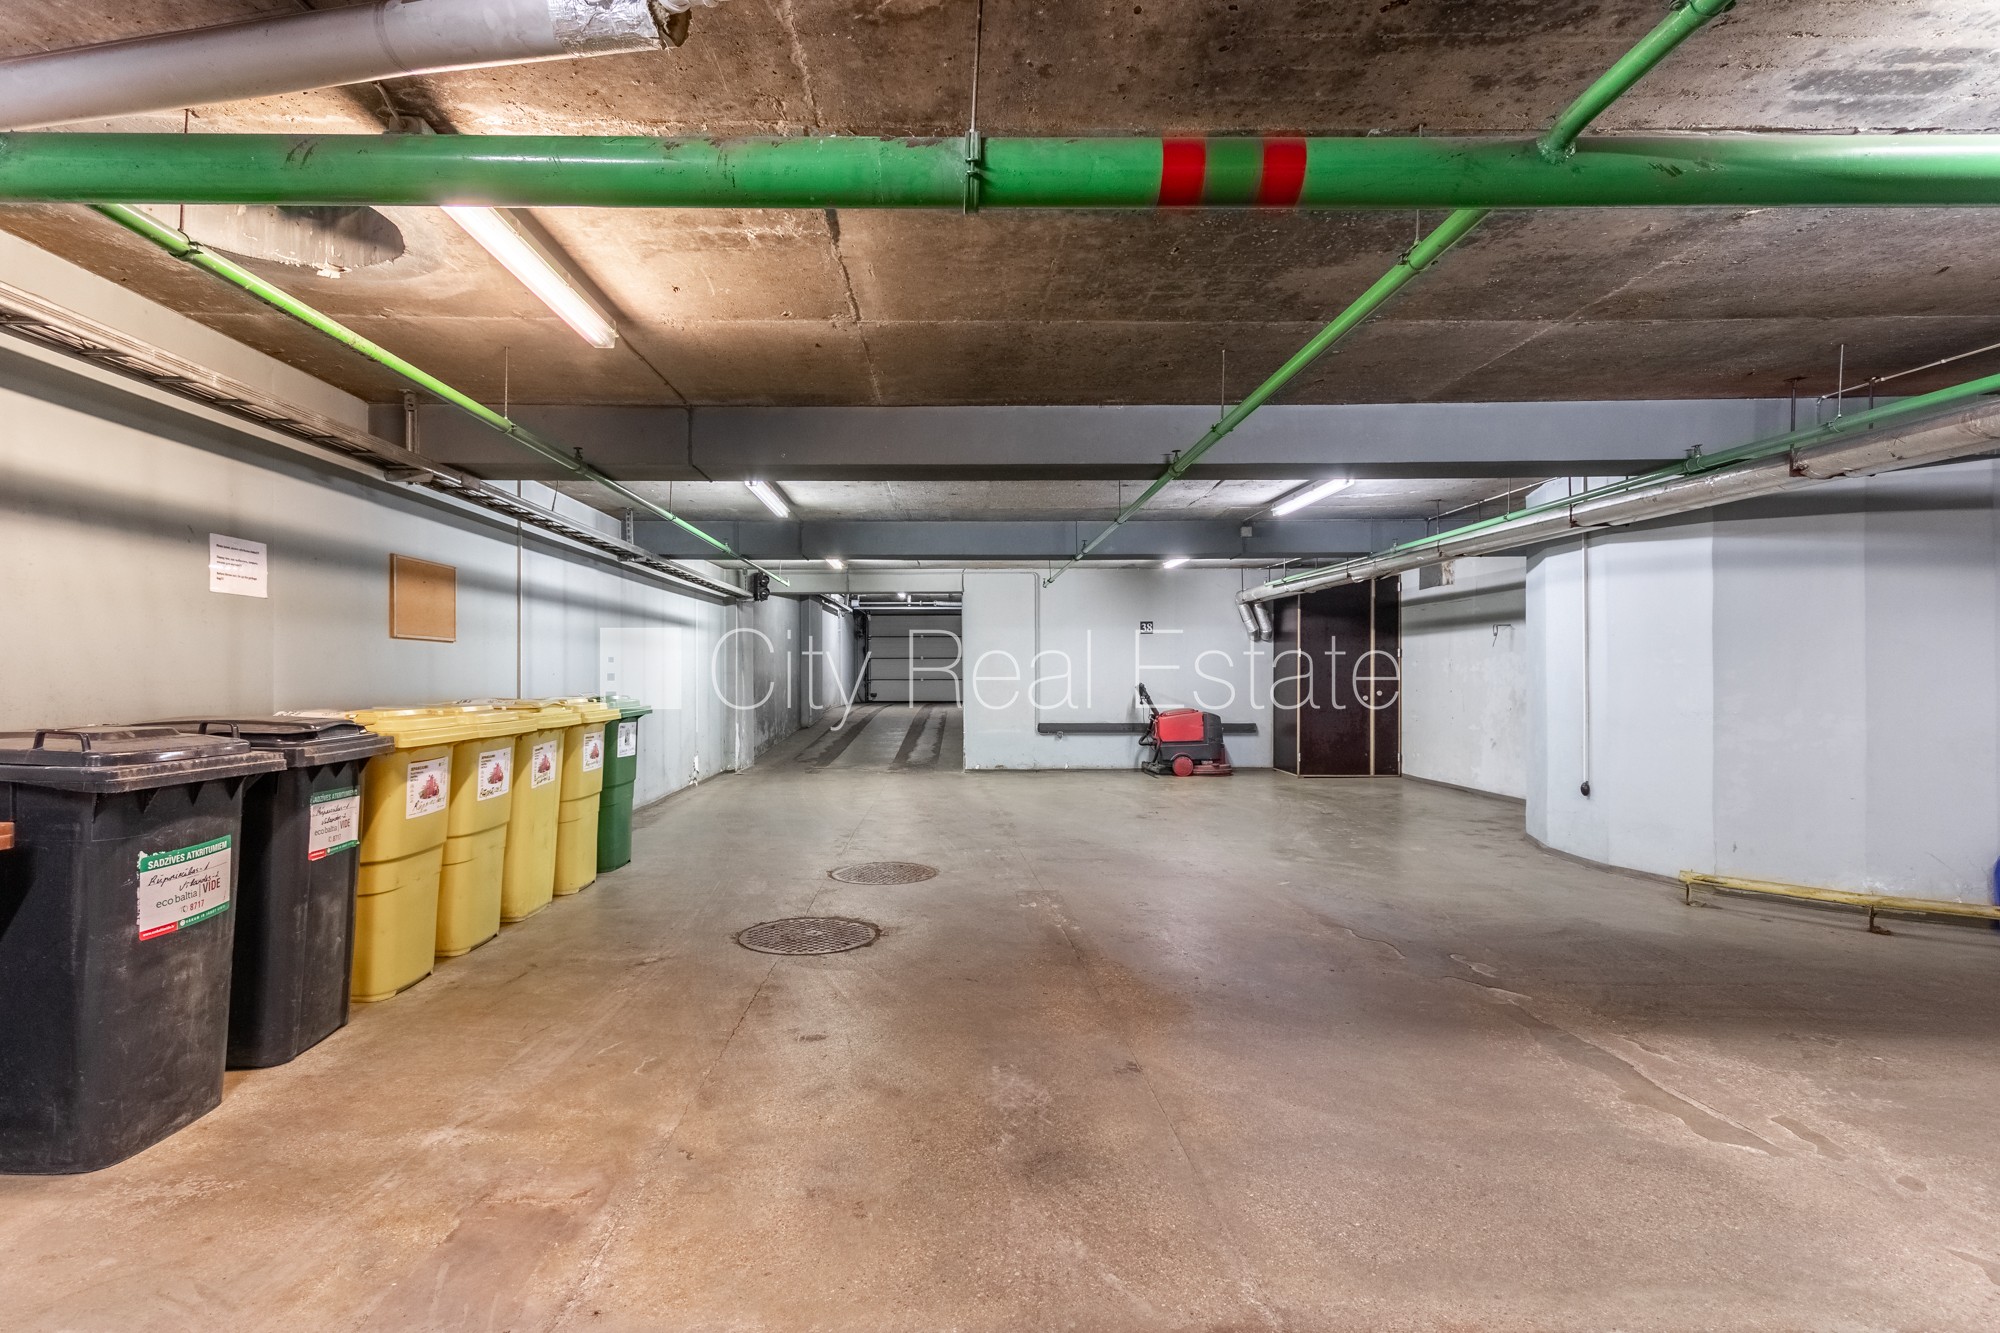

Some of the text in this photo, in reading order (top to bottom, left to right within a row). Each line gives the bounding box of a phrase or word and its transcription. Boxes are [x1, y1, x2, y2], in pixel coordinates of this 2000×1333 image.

[1141, 623, 1153, 633] 38
[186, 840, 228, 860] ATKRITUMIEM
[156, 878, 221, 909] eco baltia VIDE
[189, 900, 205, 911] 8717
